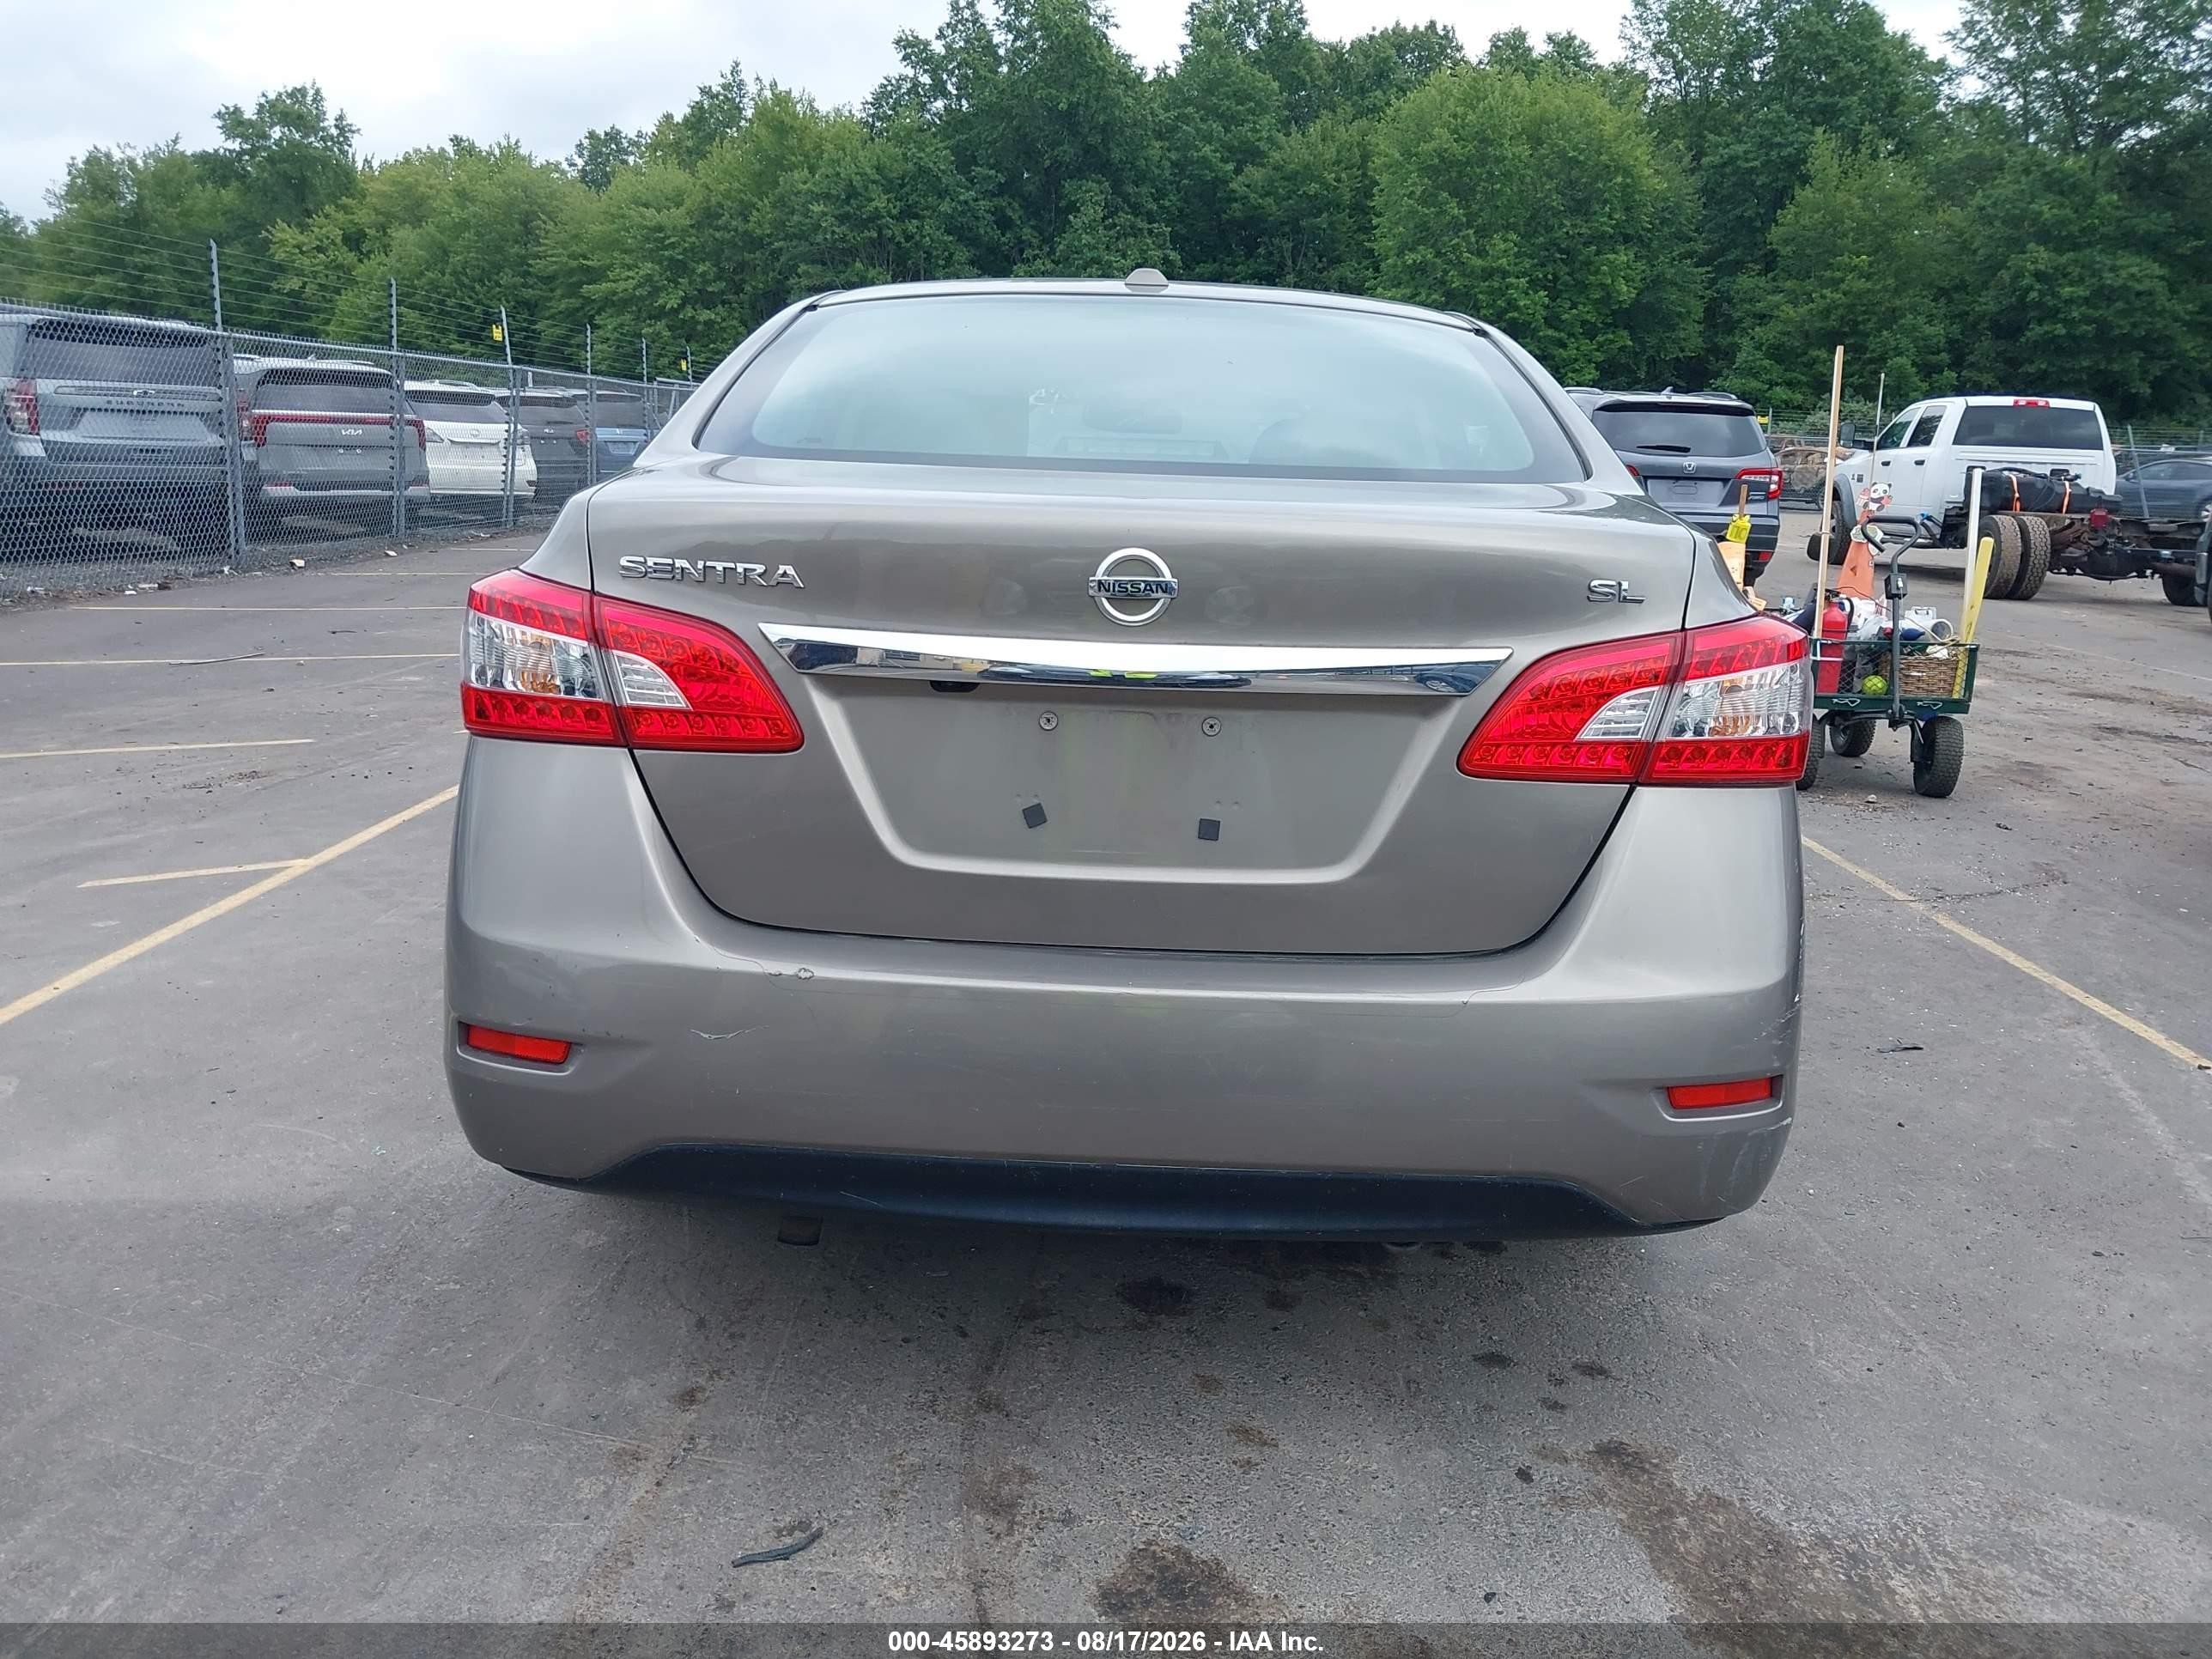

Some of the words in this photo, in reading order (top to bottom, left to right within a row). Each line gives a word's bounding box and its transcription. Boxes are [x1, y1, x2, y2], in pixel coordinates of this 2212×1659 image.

[618, 556, 805, 588] SENTRA
[1097, 580, 1169, 594] NISSAN
[1587, 580, 1646, 604] SL
